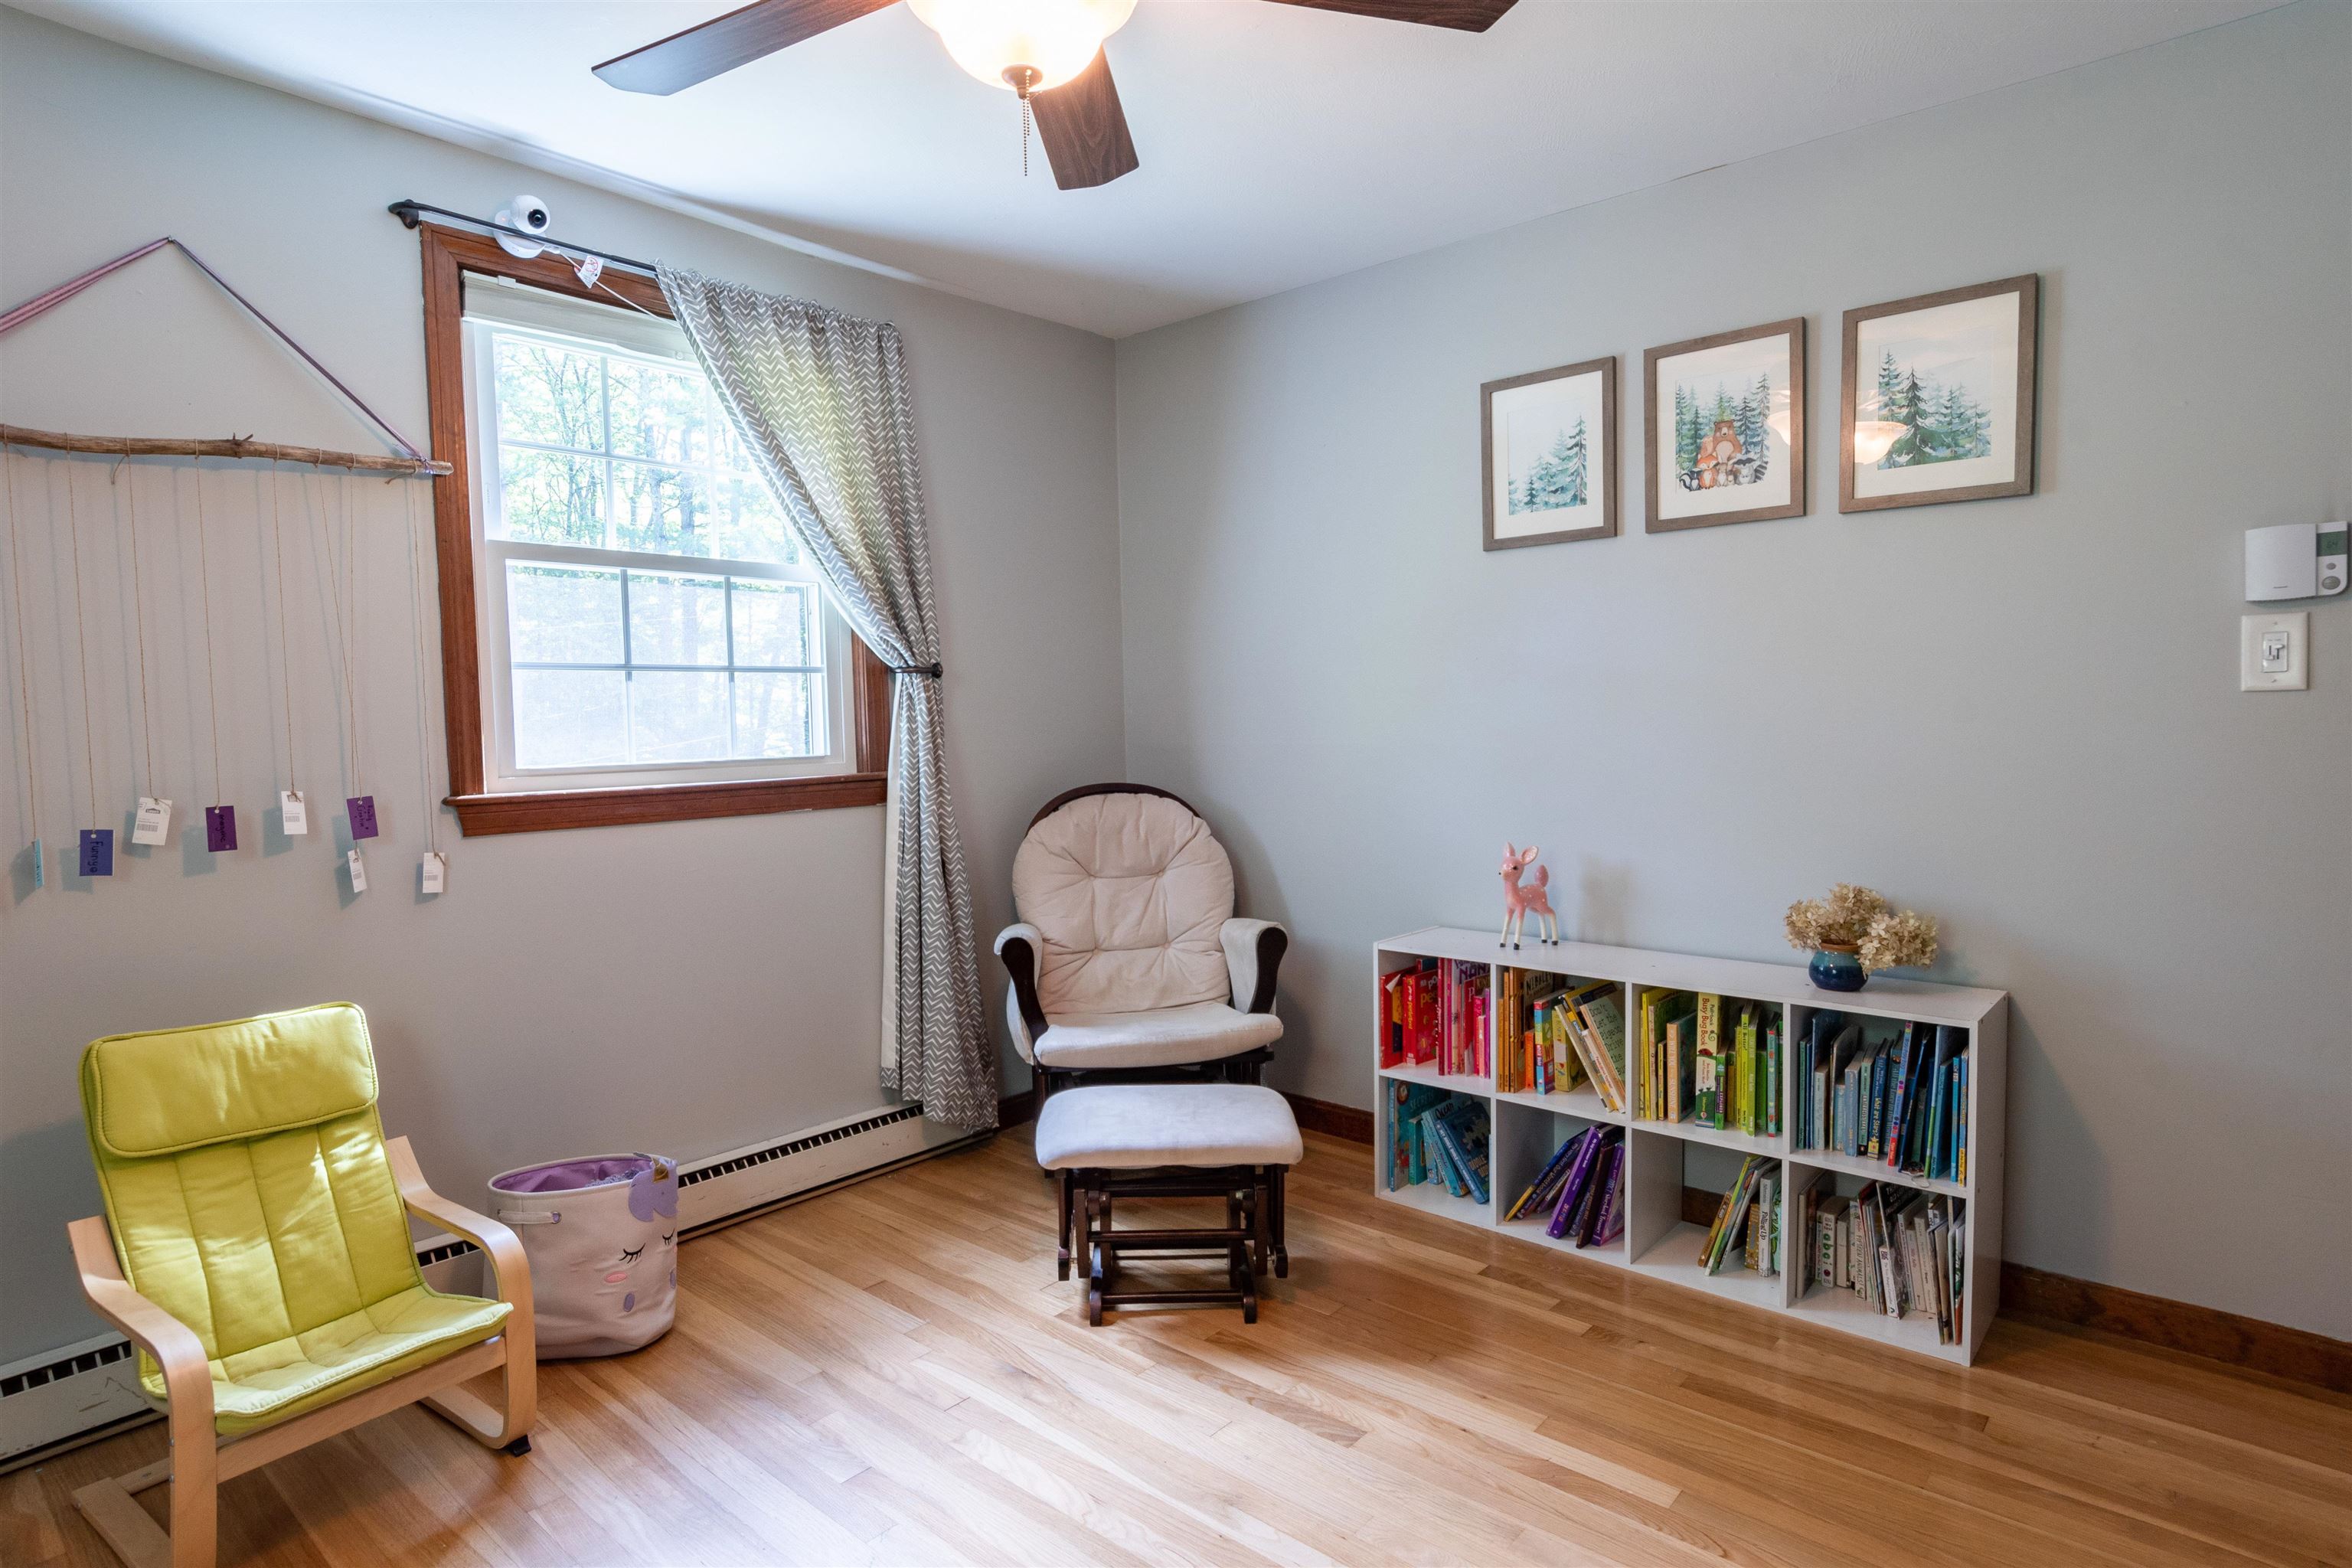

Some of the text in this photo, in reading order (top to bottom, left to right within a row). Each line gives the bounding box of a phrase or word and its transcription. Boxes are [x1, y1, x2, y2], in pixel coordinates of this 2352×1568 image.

[1607, 1013, 1617, 1023] the
[1600, 1026, 1622, 1040] Pigeon
[1606, 1038, 1624, 1052] Drive
[1611, 1053, 1623, 1062] the
[1435, 1102, 1455, 1120] Ocean
[1760, 1230, 1767, 1240] Up
